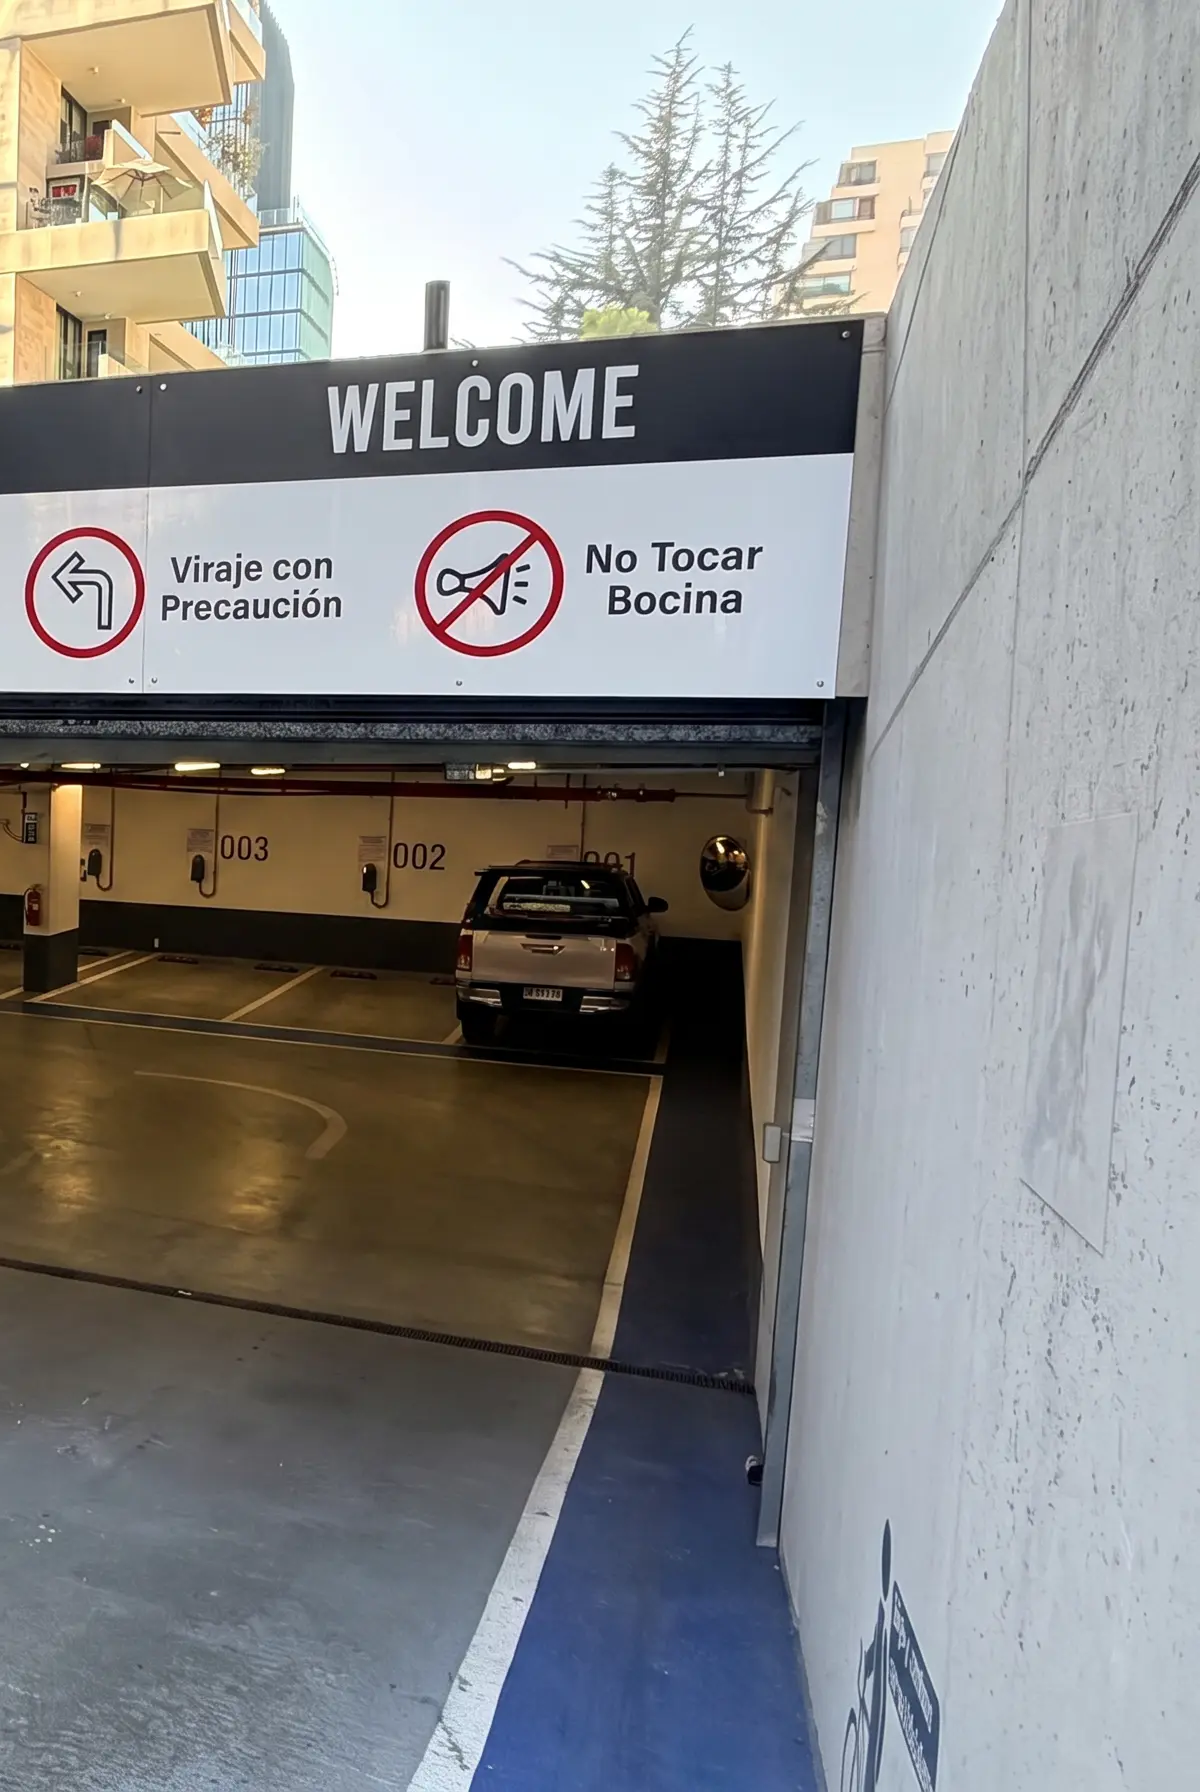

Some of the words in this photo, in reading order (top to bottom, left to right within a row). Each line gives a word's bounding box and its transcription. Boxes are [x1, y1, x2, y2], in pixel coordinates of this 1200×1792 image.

[328, 363, 639, 453] WELCOME
[171, 553, 262, 589] Viraje
[273, 558, 332, 580] con
[587, 544, 637, 573] No
[652, 542, 763, 571] Tocar
[162, 587, 341, 620] Precaución
[608, 583, 742, 614] Bocina
[221, 835, 268, 861] 003
[394, 843, 445, 870] 002
